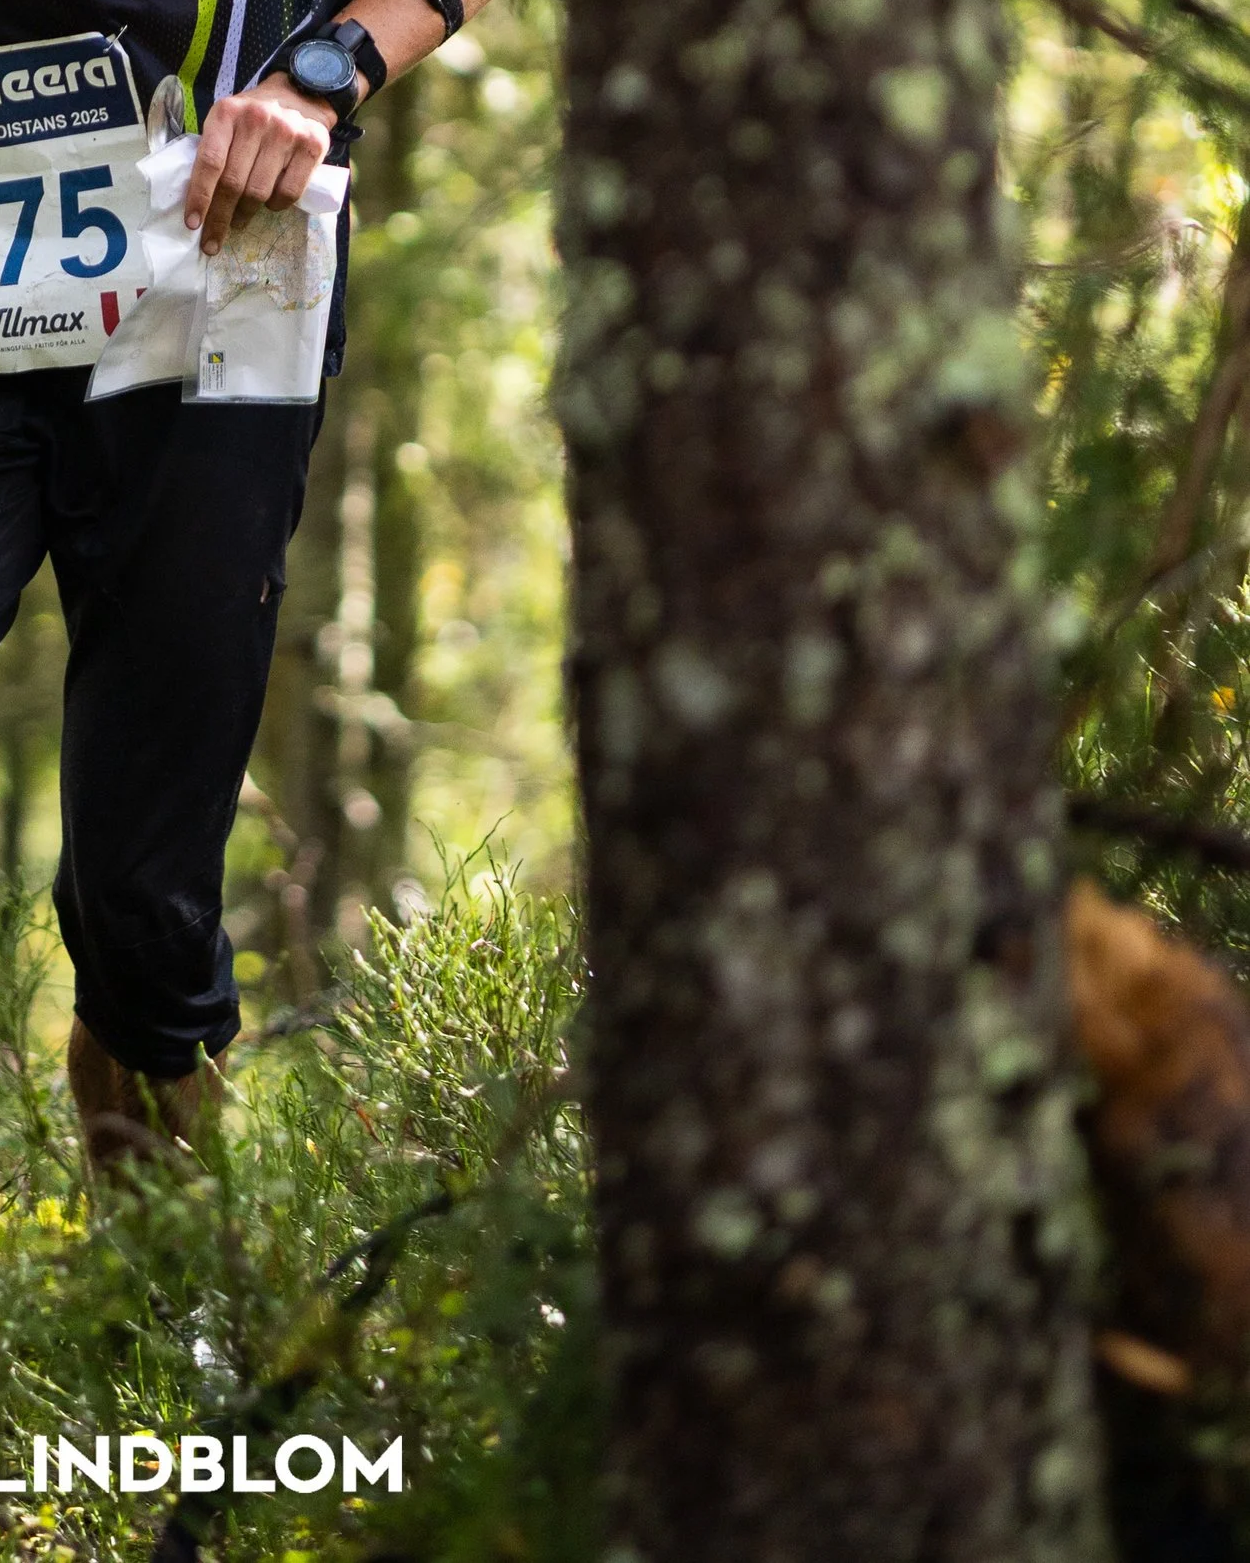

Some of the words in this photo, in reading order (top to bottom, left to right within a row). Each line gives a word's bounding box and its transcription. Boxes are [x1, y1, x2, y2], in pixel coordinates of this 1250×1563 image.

[70, 107, 109, 127] 2025
[34, 342, 54, 351] FRITID
[55, 339, 68, 347] FÖR
[70, 338, 86, 346] ALLA
